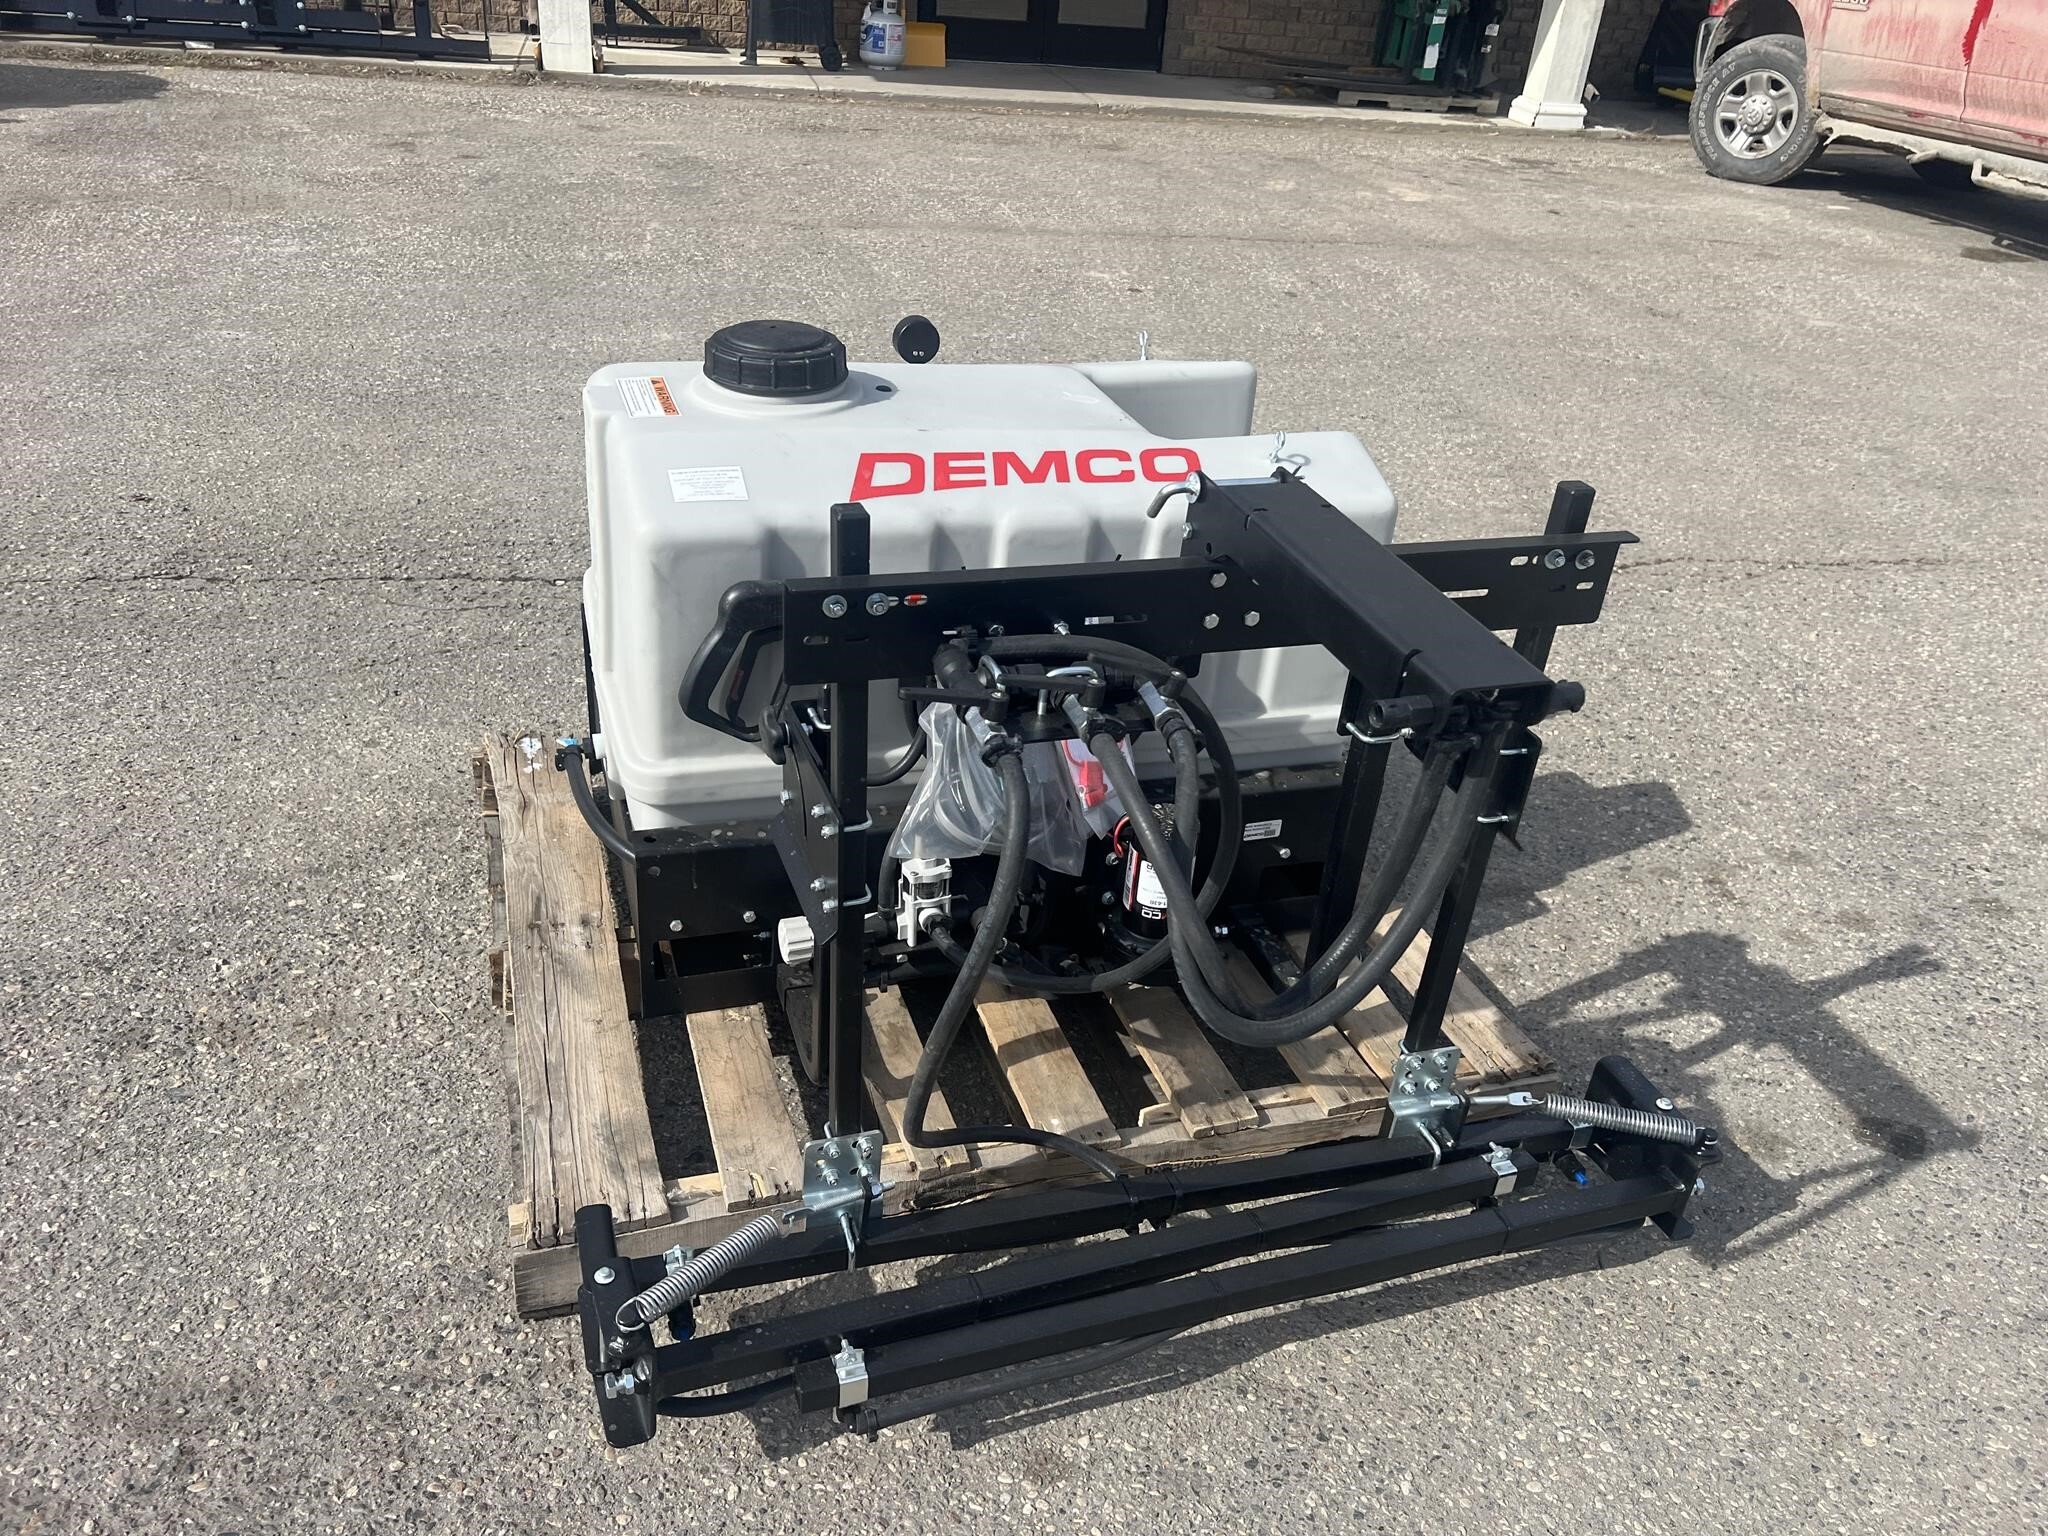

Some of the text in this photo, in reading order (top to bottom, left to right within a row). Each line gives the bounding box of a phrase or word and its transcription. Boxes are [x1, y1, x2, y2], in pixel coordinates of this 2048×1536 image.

[1698, 62, 1736, 160] TRANSFORCE AT
[655, 387, 675, 413] WARNING
[849, 448, 1201, 502] DEMCO
